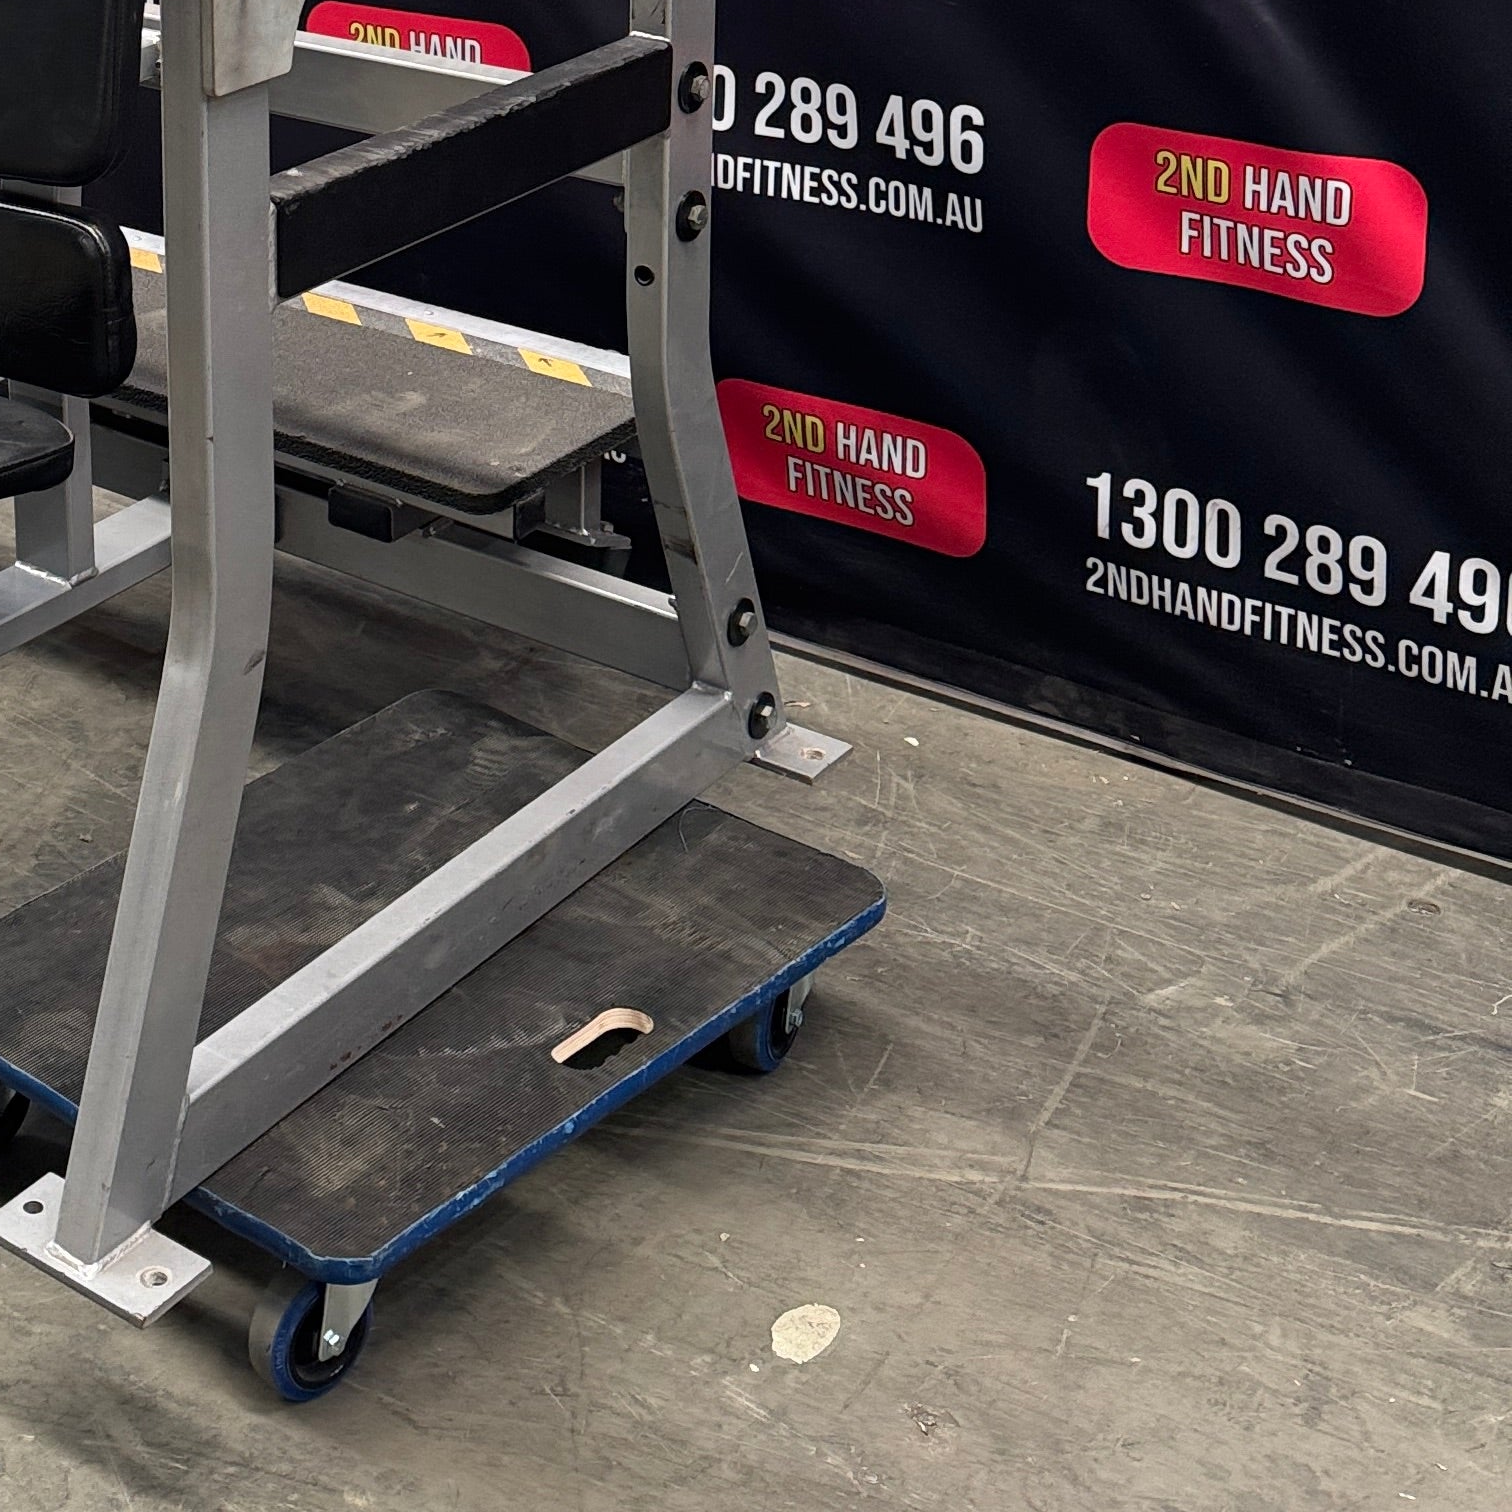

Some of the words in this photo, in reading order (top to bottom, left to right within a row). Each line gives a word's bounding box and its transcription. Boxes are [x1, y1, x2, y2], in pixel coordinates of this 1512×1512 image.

[754, 71, 858, 150] 289
[875, 94, 985, 175] 496
[712, 152, 983, 233] DFITNESS.COM.AU
[1156, 150, 1229, 204] 2ND
[1244, 165, 1351, 226] HAND
[1180, 211, 1333, 284] FITNESS
[763, 404, 825, 453] 2ND
[836, 421, 926, 479] HAND
[787, 456, 913, 525] FITNESS
[1086, 472, 1242, 569] 1300
[1263, 514, 1387, 607] 289
[1409, 550, 1512, 636] 49
[1086, 556, 1512, 704] 2NDHANDFITNESS.COM.A
